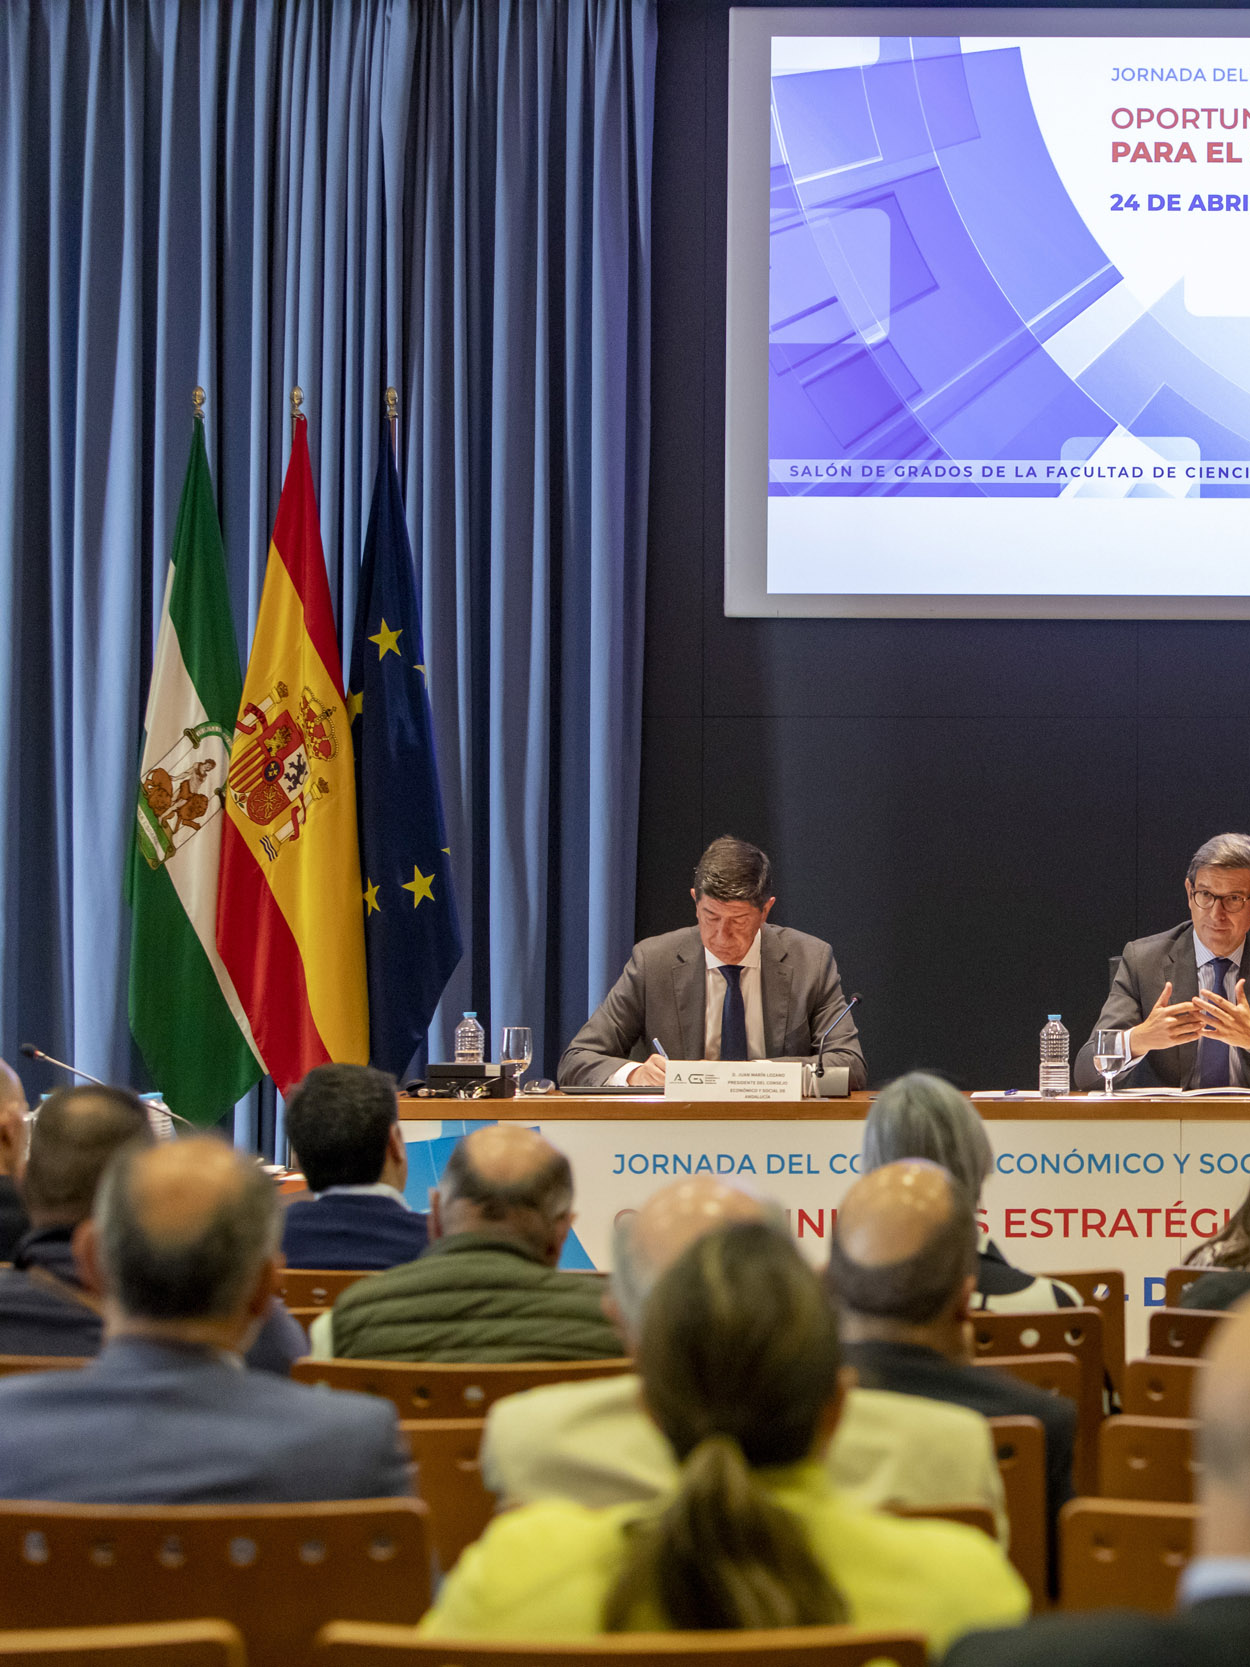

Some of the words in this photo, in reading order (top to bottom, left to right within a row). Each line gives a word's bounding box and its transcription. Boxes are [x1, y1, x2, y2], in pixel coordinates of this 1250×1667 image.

[1110, 67, 1207, 82] JORNADA
[1212, 67, 1249, 82] DEL
[1111, 141, 1198, 164] PARA
[1206, 141, 1243, 164] EL
[1109, 193, 1141, 212] 24
[1147, 193, 1182, 212] DE
[789, 462, 852, 478] SALÓN
[861, 465, 886, 478] DE
[894, 465, 974, 478] GRADOS
[981, 465, 1006, 478] DE
[1014, 465, 1038, 478] LA
[1045, 466, 1145, 479] FACULTAD
[1152, 466, 1177, 479] DE
[612, 1153, 757, 1175] JORNADA
[766, 1153, 820, 1175] DEL
[996, 1147, 1165, 1175] CONÓMICO
[1173, 1153, 1190, 1174] Y
